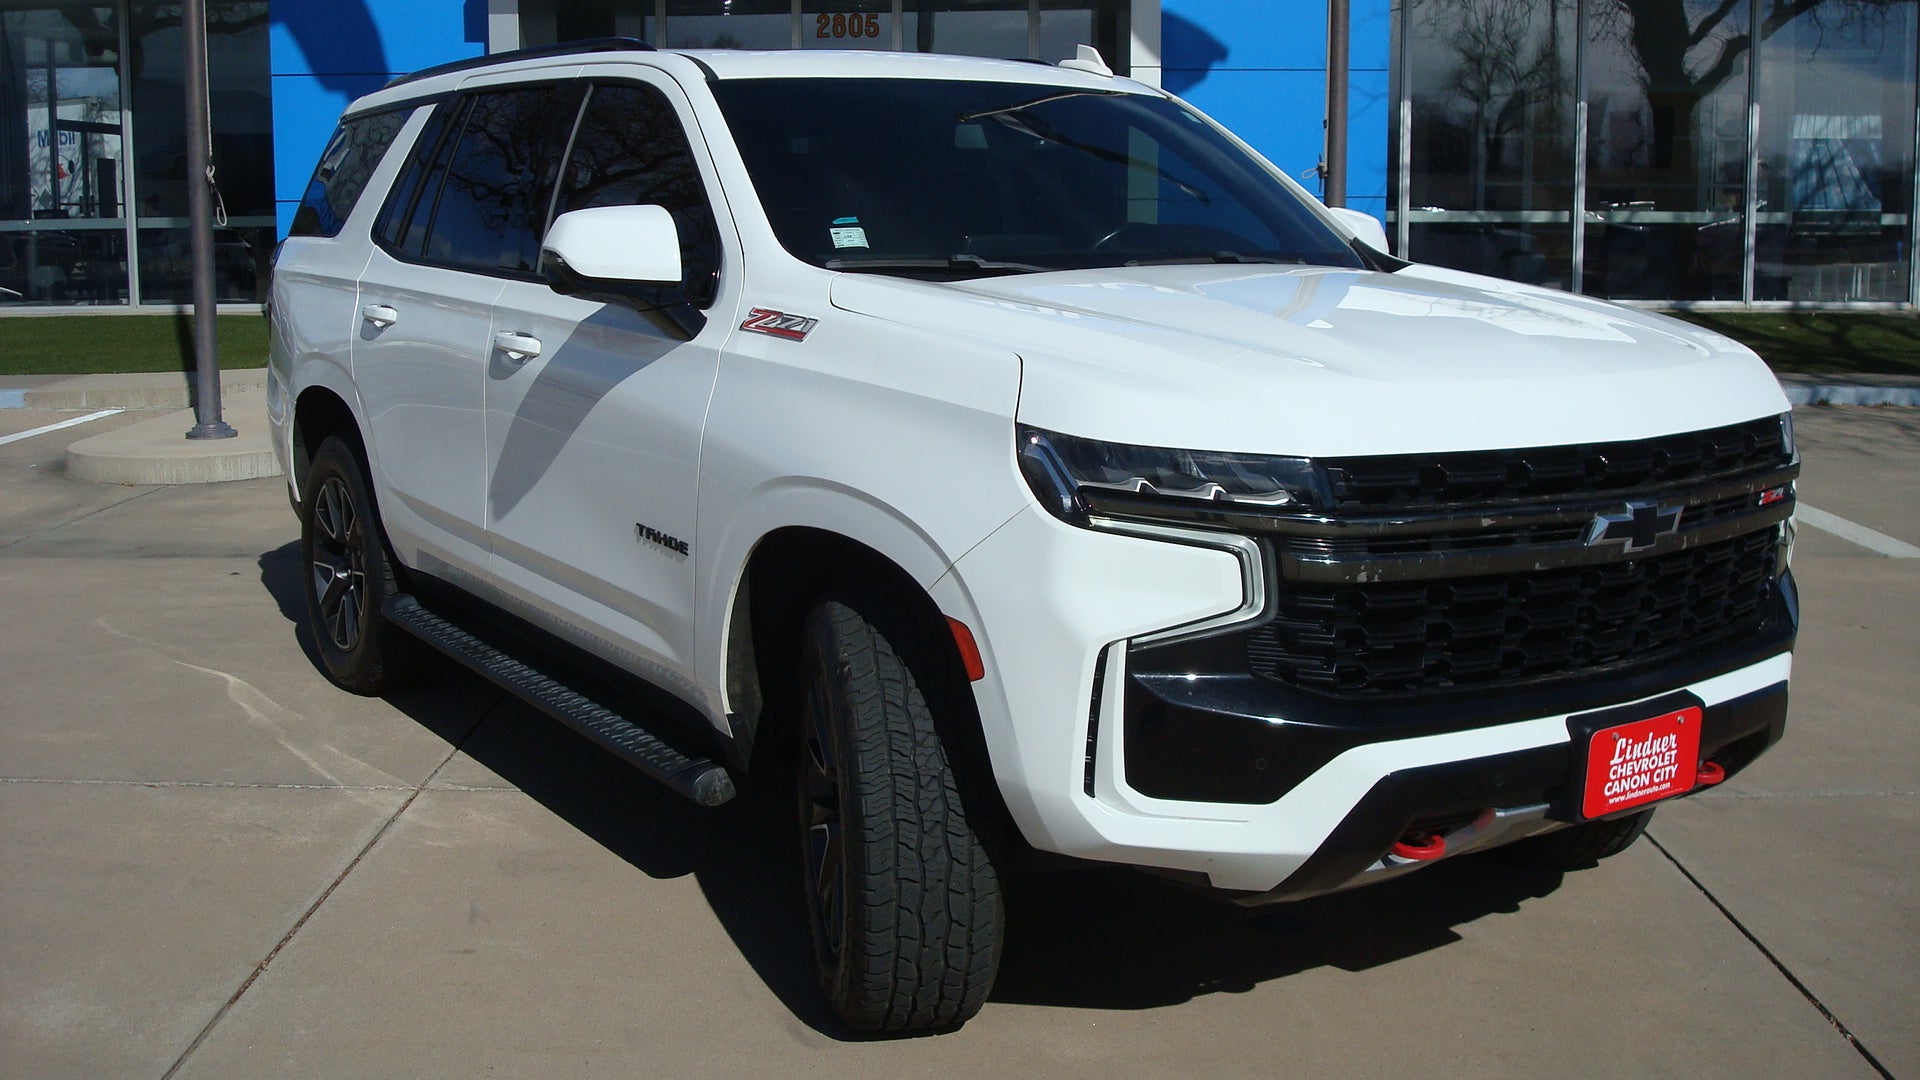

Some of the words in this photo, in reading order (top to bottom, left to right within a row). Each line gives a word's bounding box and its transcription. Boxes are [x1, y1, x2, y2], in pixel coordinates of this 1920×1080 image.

[816, 13, 879, 38] 2805
[37, 129, 76, 148] Mbil
[738, 307, 819, 342] Z71
[636, 522, 689, 556] TAHOE
[1609, 750, 1677, 780] CHEVROLET
[1610, 732, 1677, 766] Lindner
[1604, 772, 1650, 796] CANON
[1653, 764, 1678, 783] CITY
